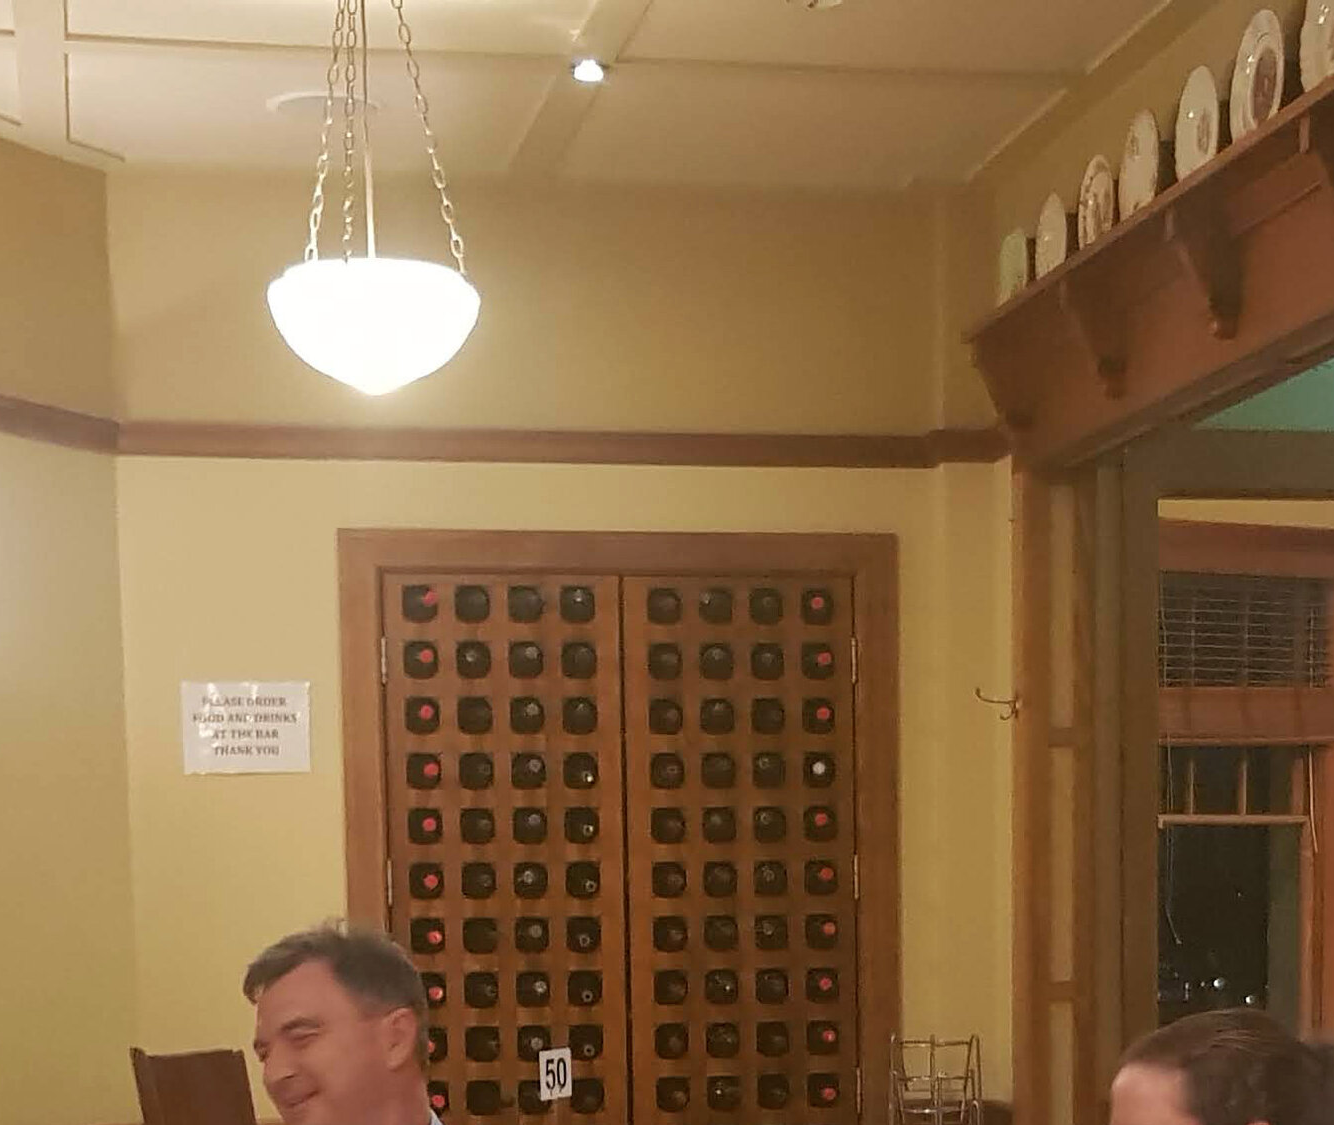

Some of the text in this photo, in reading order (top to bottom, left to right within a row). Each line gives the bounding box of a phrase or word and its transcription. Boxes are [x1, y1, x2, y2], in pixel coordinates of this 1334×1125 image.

[212, 730, 279, 739] AT THE BAR
[214, 746, 280, 756] THANK YOU
[545, 1057, 567, 1091] 50
